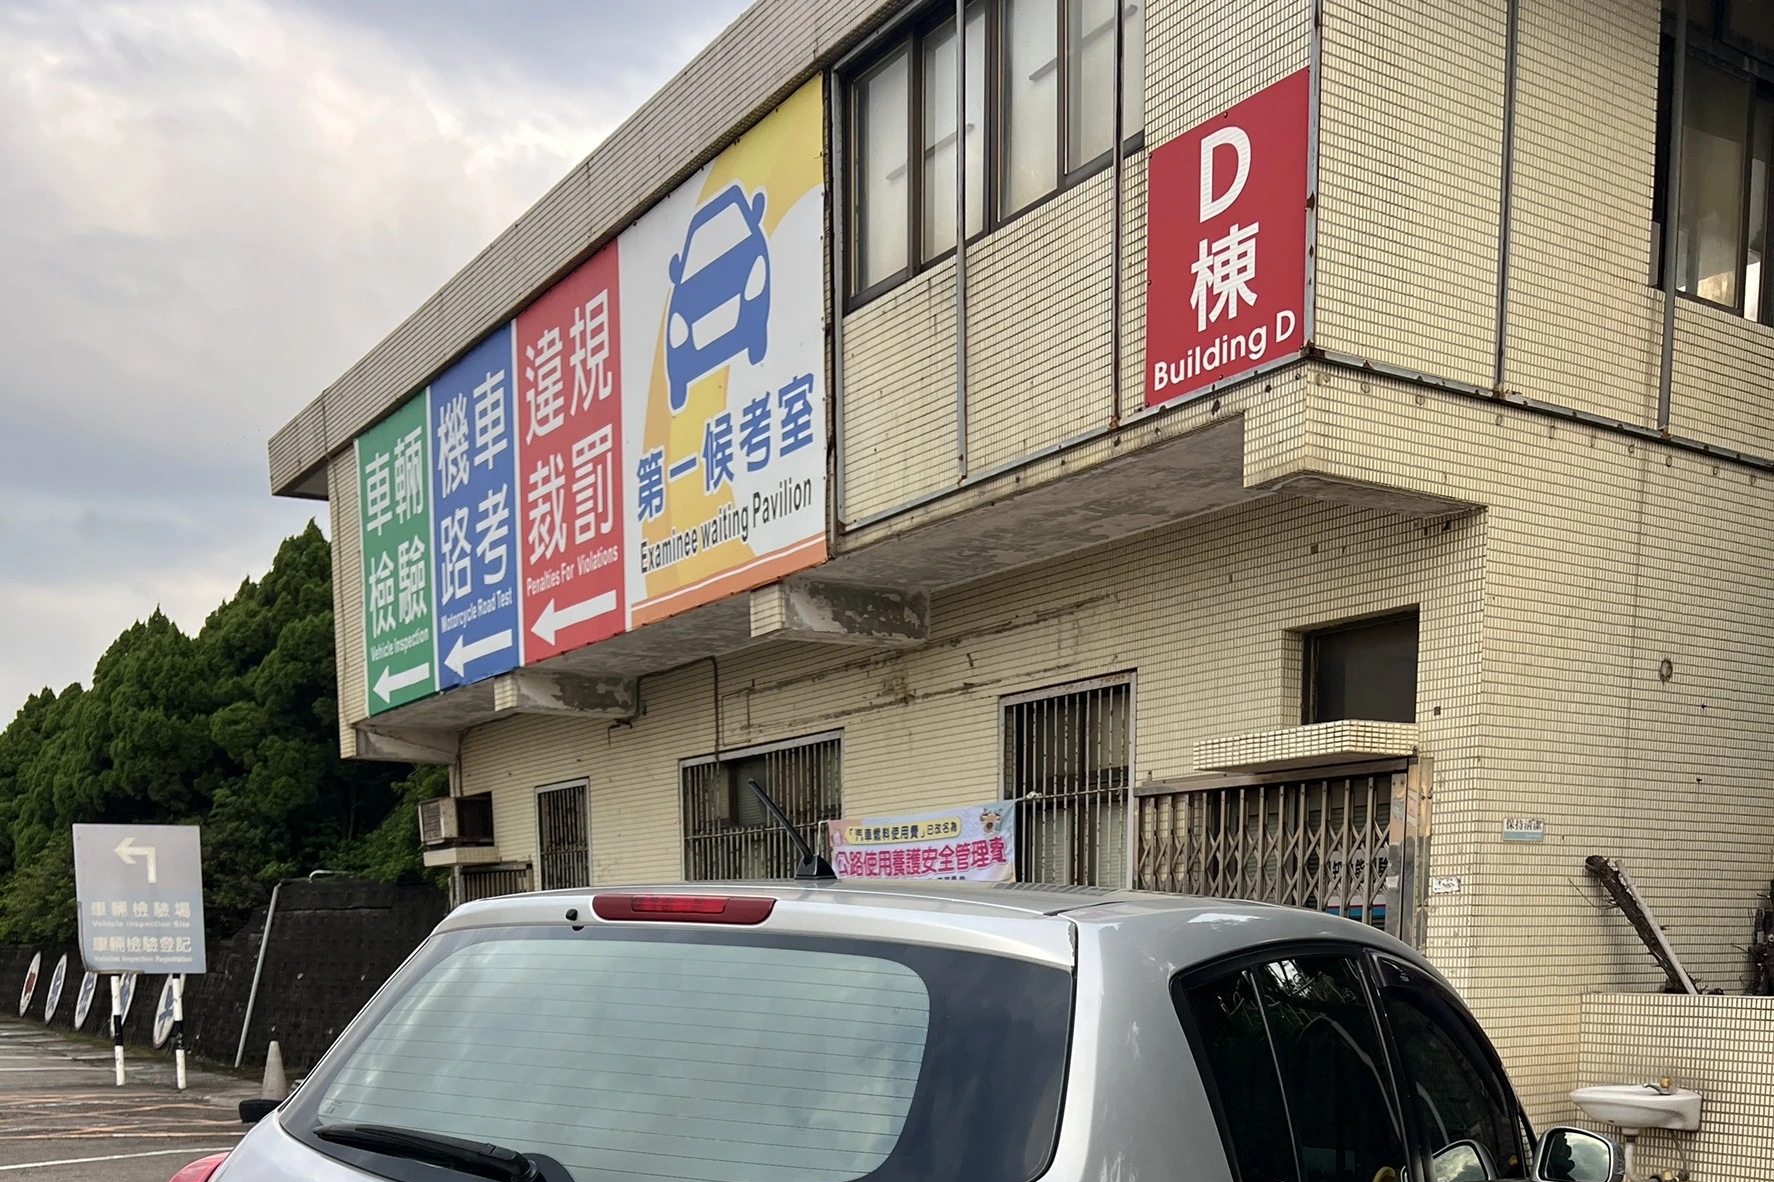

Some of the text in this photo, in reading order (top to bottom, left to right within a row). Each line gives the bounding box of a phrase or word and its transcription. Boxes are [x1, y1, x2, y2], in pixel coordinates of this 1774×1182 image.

[525, 288, 613, 446] 違規
[1154, 309, 1296, 391] Building D
[364, 425, 424, 536] 車輛
[437, 368, 508, 499] 機車
[636, 373, 814, 522] 第一候考室
[440, 482, 509, 607] 路考
[528, 423, 614, 566] 裁罰
[640, 477, 812, 574] Examinee waiting Pavilion
[368, 534, 428, 639] 檢驗
[441, 588, 513, 633] Motorcycle Road Test
[526, 545, 619, 597] Penalties For Violations
[370, 628, 430, 662] Vehicle Inspection
[836, 836, 1008, 876] 公路使用養護安全管理費
[92, 920, 123, 928] Vehicle
[173, 920, 191, 928] Site
